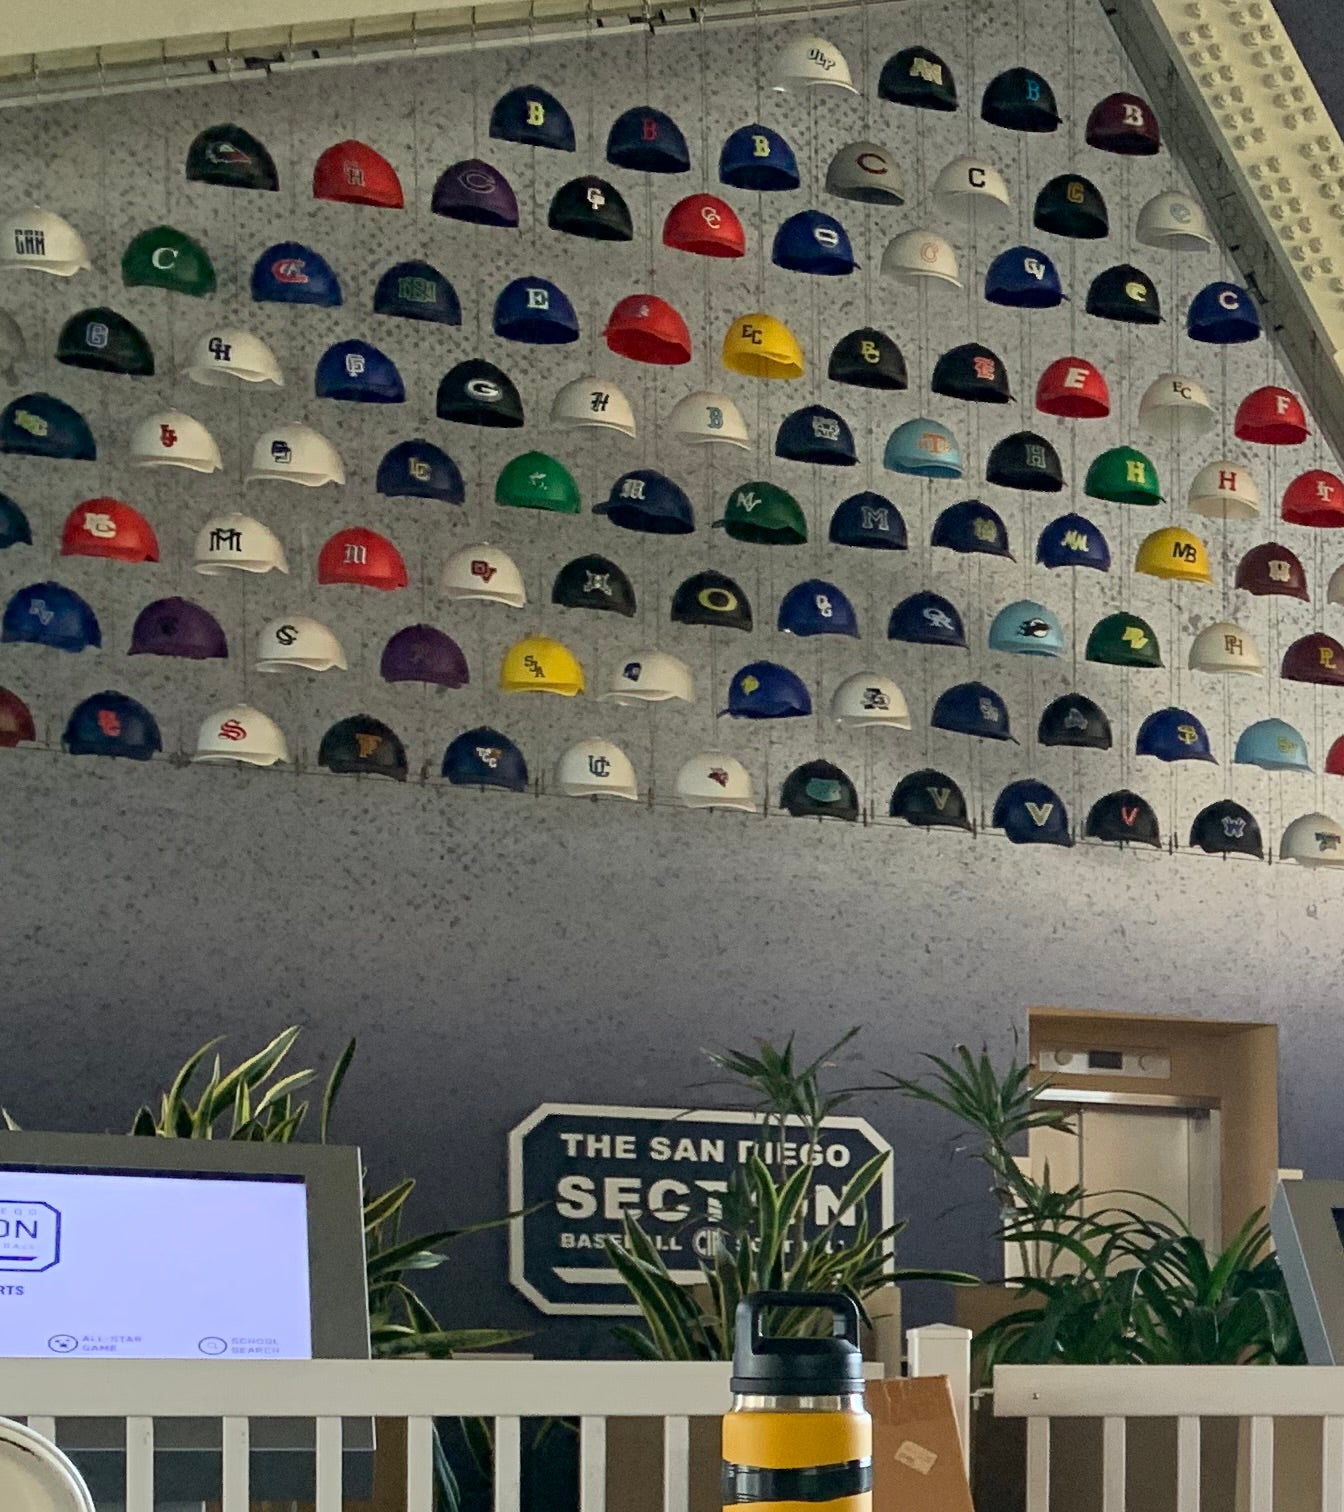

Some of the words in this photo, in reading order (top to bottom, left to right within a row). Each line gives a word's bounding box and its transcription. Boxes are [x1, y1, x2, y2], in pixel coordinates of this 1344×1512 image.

[1027, 80, 1040, 100] B
[527, 102, 544, 125] B
[1124, 104, 1144, 126] B
[752, 136, 770, 157] B
[857, 154, 888, 174] C
[969, 168, 986, 187] C
[152, 248, 179, 269] C
[1219, 291, 1239, 309] C
[742, 324, 763, 344] EC
[1064, 368, 1089, 388] E
[466, 379, 500, 399] G
[1172, 382, 1192, 400] EC
[1276, 396, 1291, 414] F
[1127, 461, 1146, 484] H
[1218, 472, 1238, 491] H
[862, 506, 890, 531] M
[1172, 542, 1197, 562] MB
[698, 588, 738, 611] O
[1224, 635, 1243, 655] PH
[927, 787, 951, 810] V
[1025, 802, 1052, 826] V
[1121, 807, 1139, 826] V
[559, 1132, 637, 1160] THE
[649, 1136, 725, 1164] SAN
